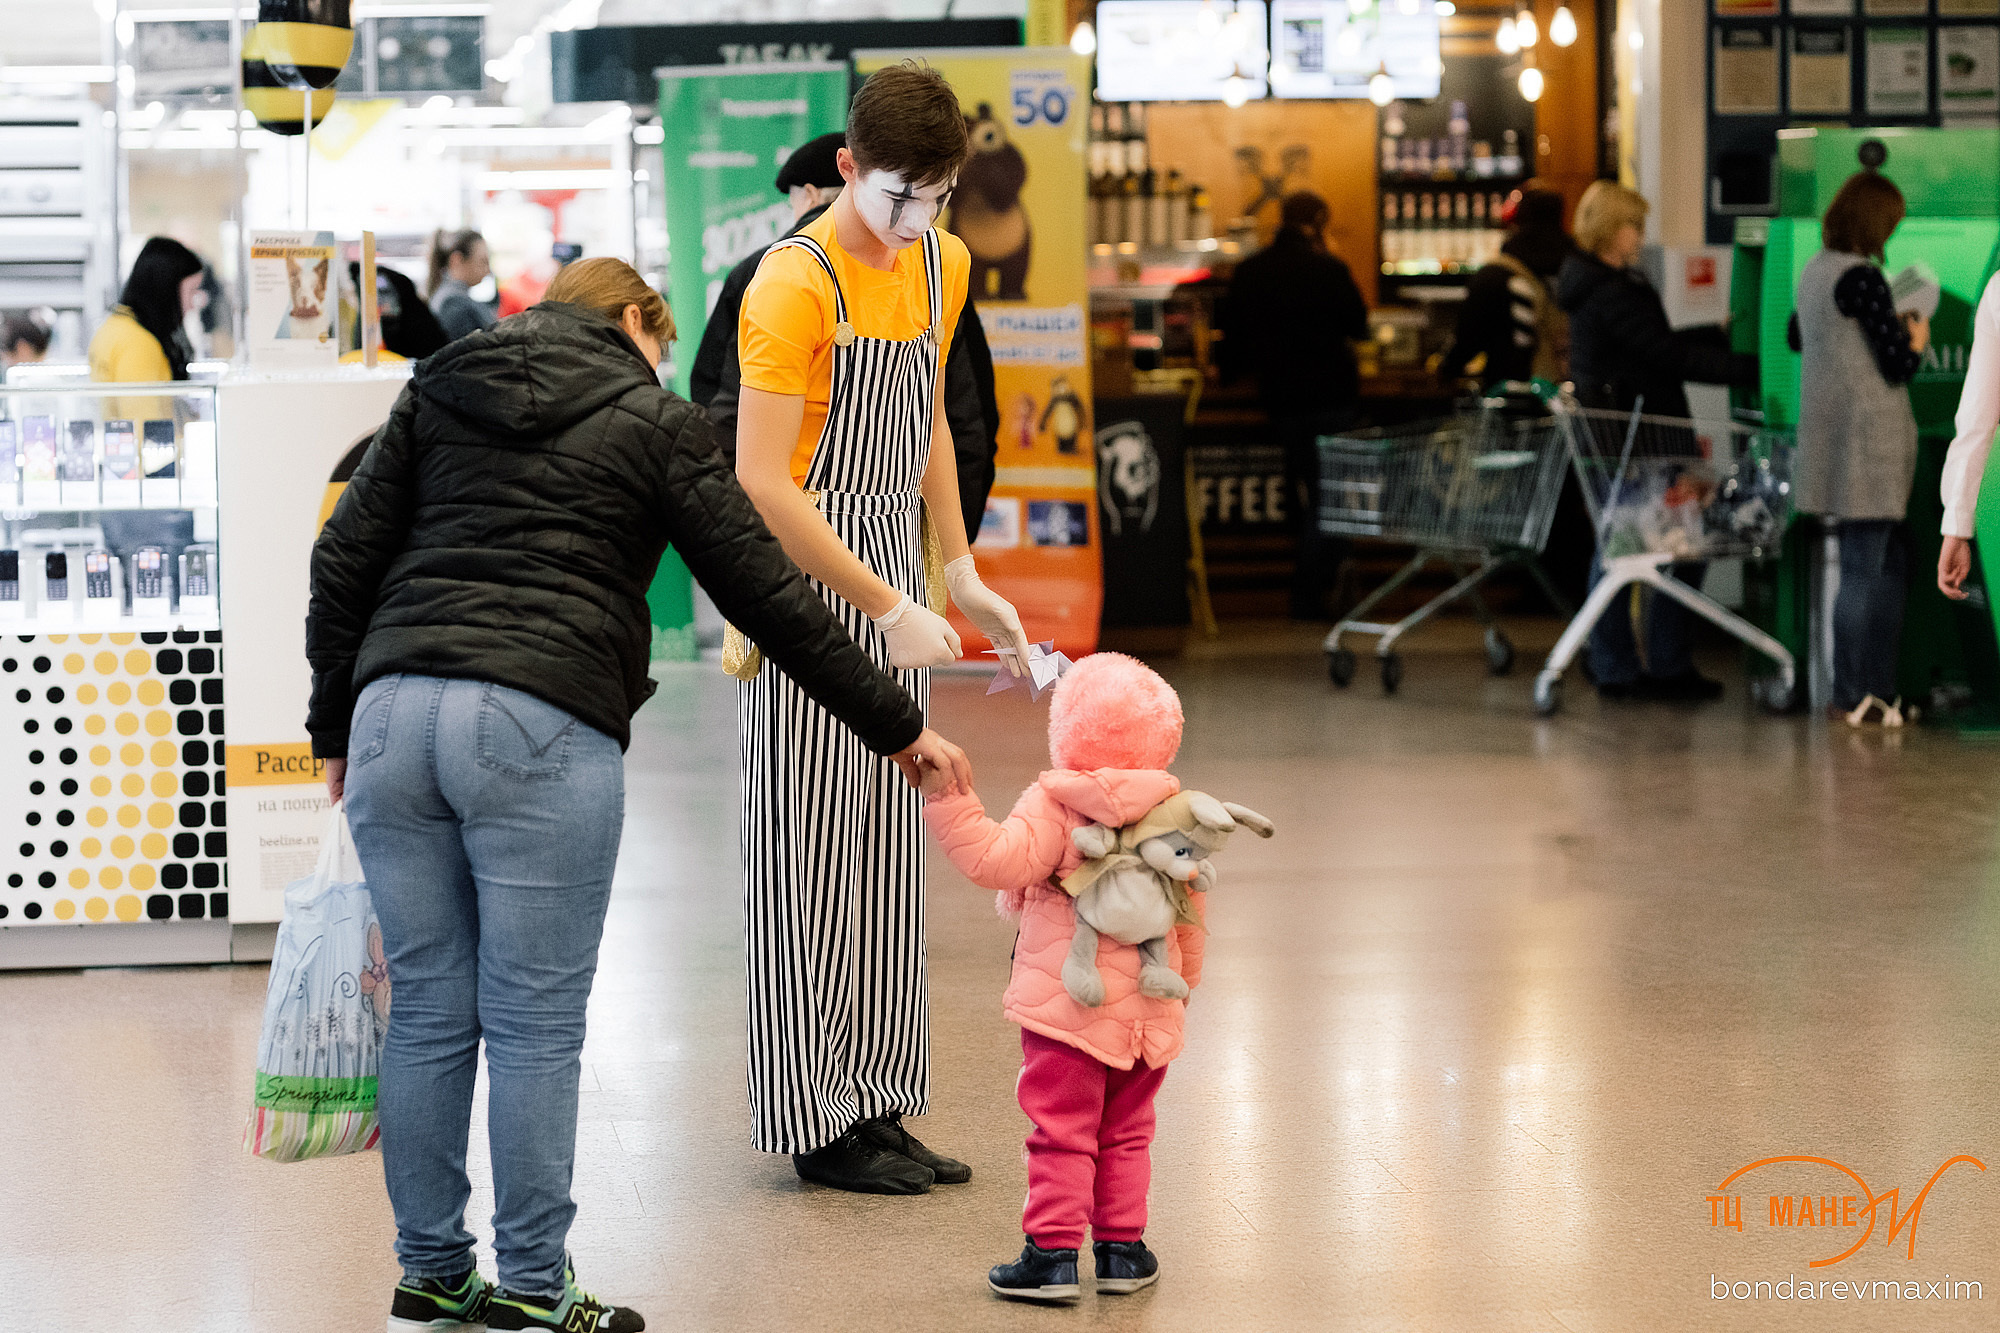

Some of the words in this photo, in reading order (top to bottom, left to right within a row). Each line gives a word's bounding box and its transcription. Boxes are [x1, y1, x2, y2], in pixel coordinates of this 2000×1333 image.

[1014, 88, 1067, 125] 50
[255, 750, 325, 777] Расср
[257, 801, 277, 812] на
